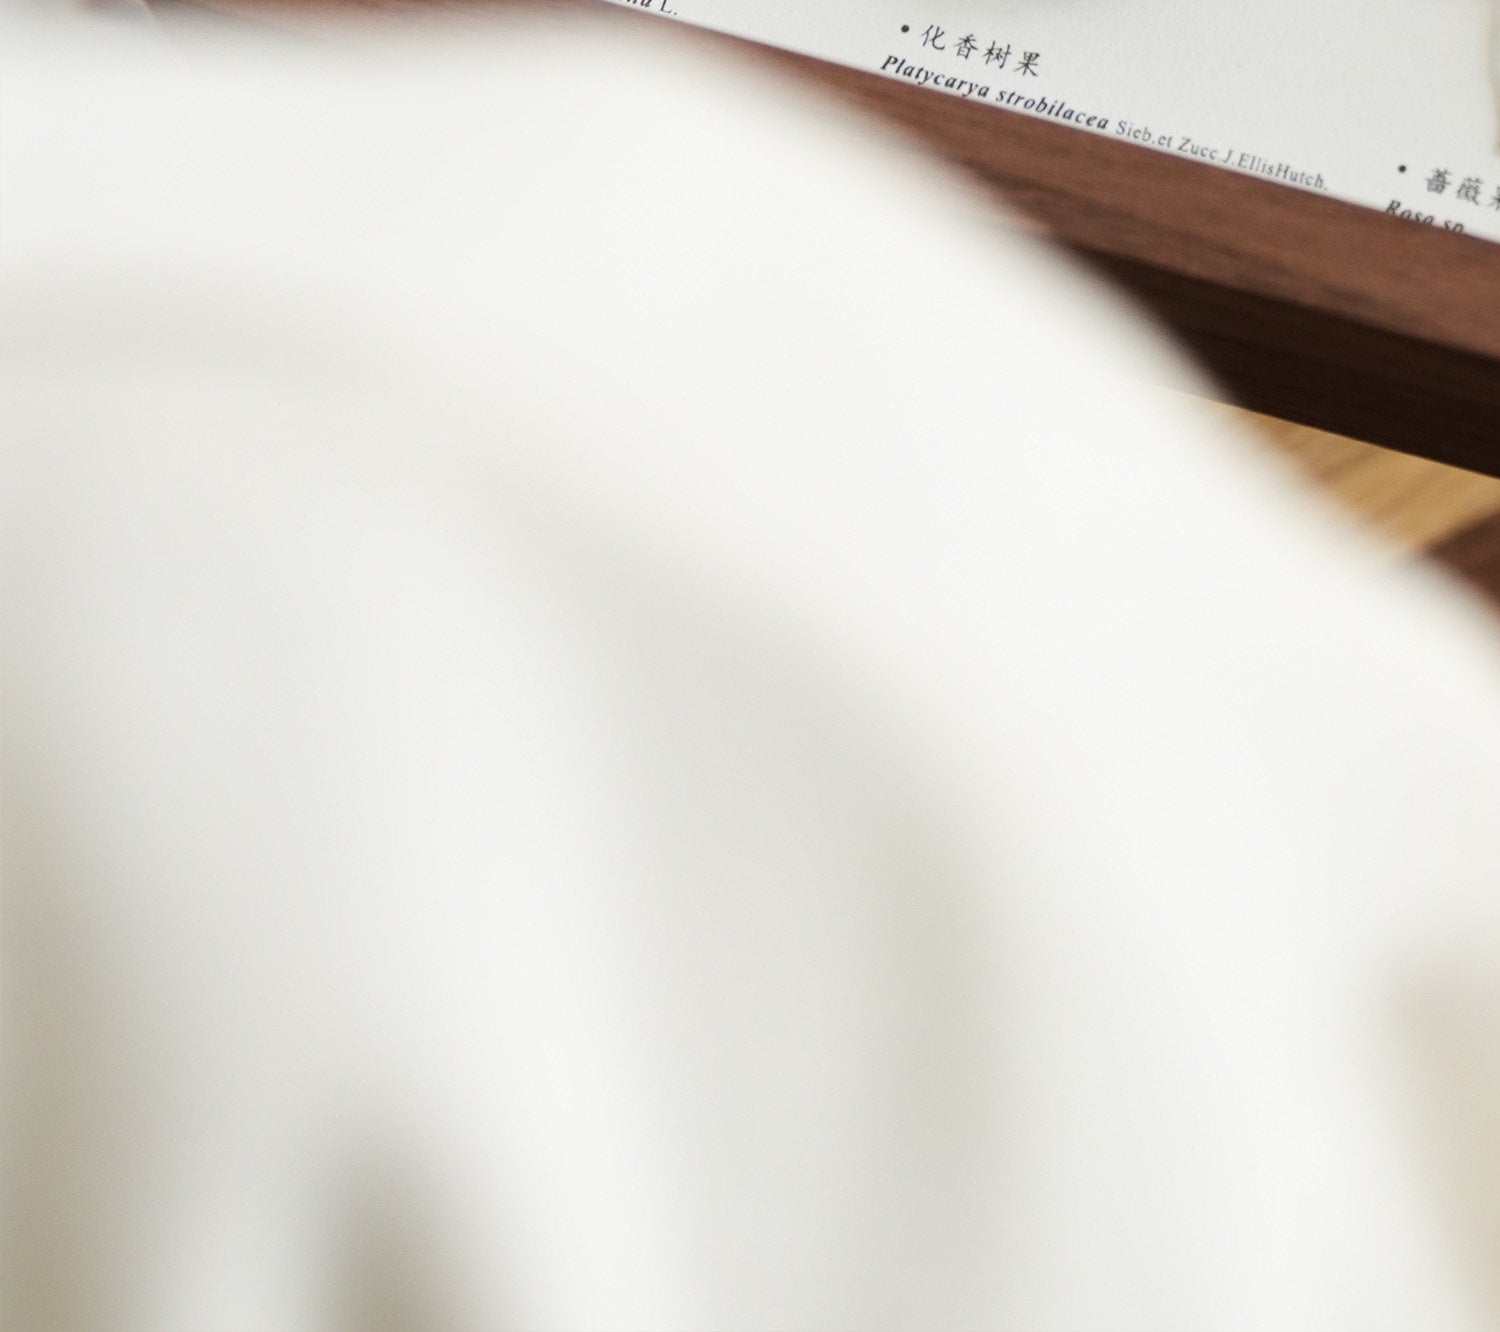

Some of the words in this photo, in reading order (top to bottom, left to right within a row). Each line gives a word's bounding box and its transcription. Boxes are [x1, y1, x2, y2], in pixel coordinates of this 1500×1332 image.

[920, 23, 1041, 78] 化香树果
[880, 54, 990, 99] Platycarya
[995, 86, 1110, 131] strobilacea
